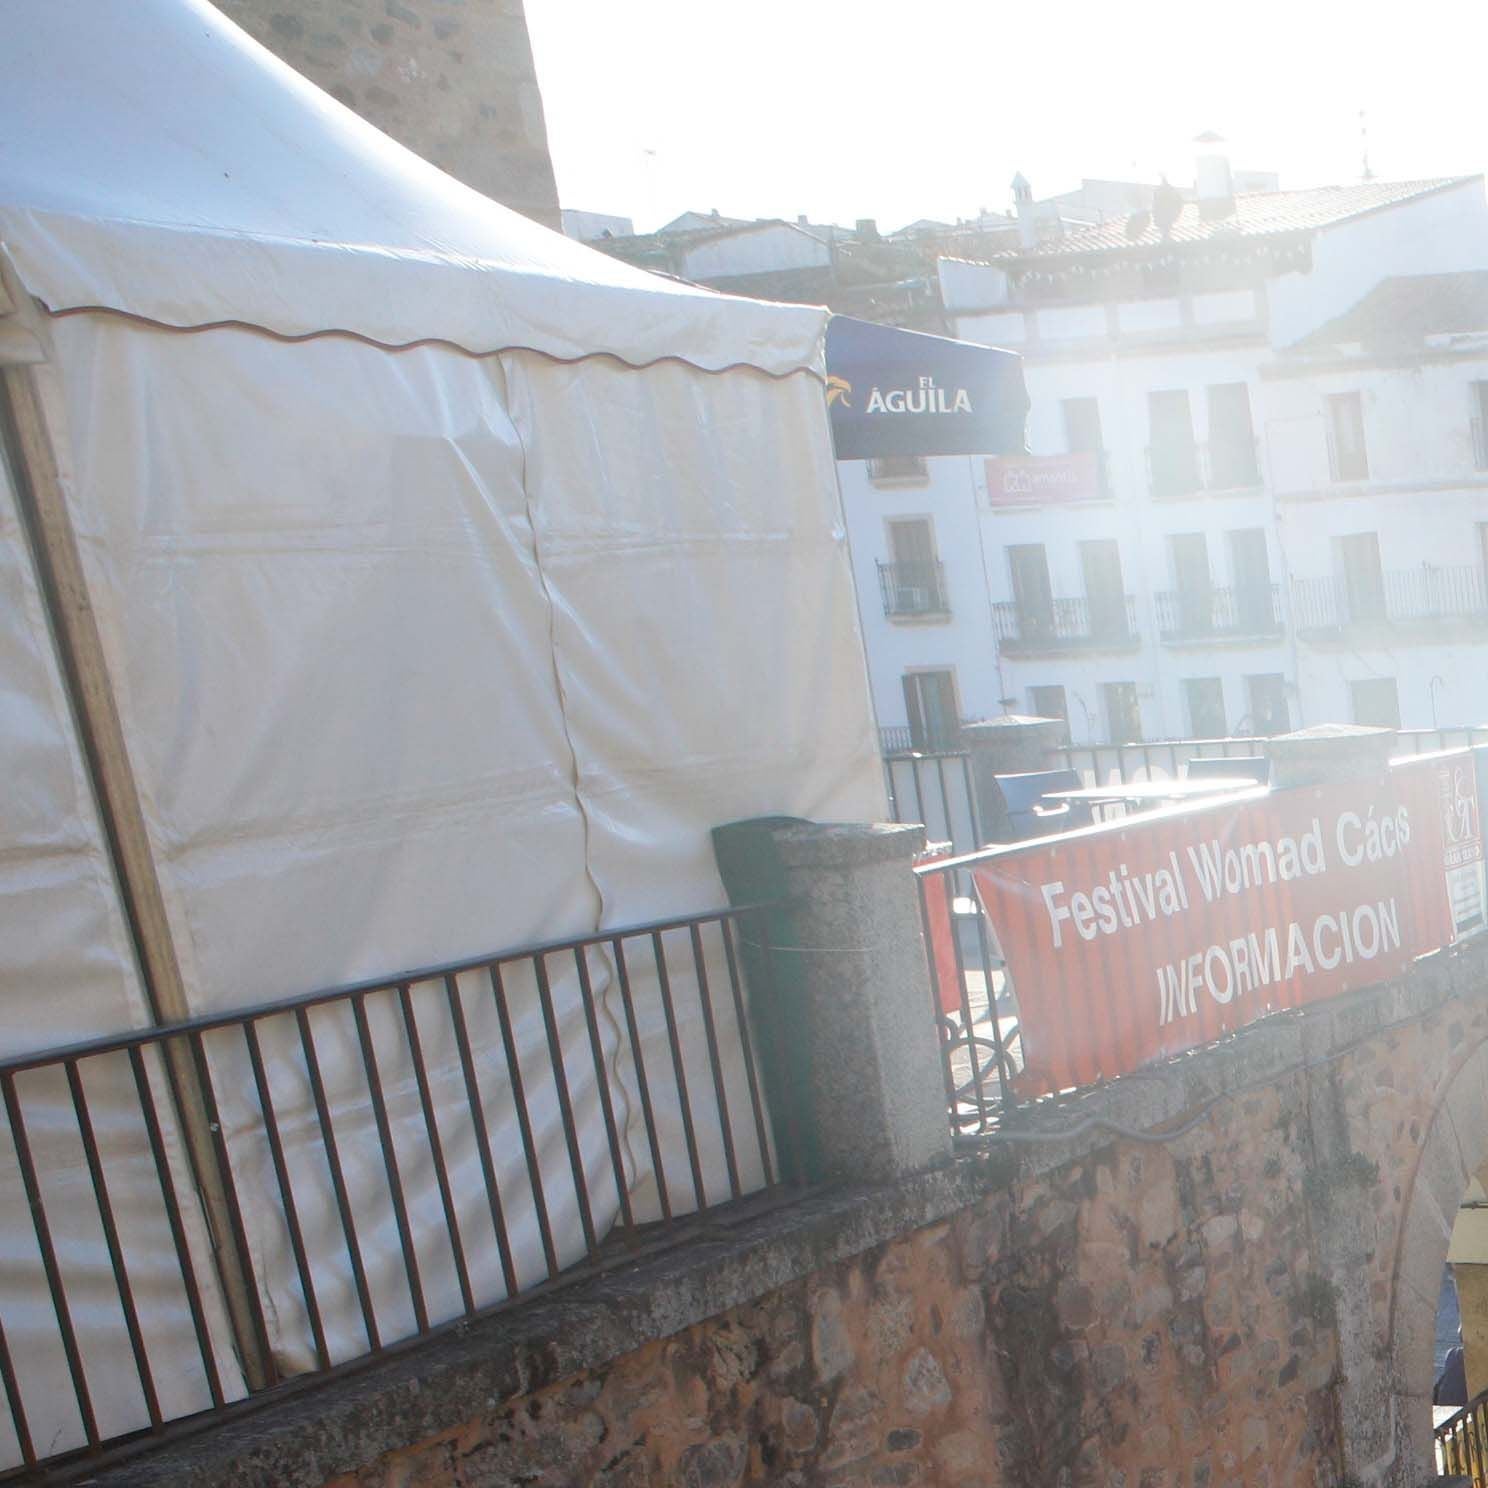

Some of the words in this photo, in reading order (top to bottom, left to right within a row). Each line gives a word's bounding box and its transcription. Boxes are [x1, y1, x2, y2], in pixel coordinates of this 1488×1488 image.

[866, 387, 973, 413] ÁGUILA
[919, 376, 936, 389] EL
[1041, 851, 1190, 948] Festival
[1187, 818, 1327, 903] Womad
[1156, 897, 1401, 1026] INFORMACION
